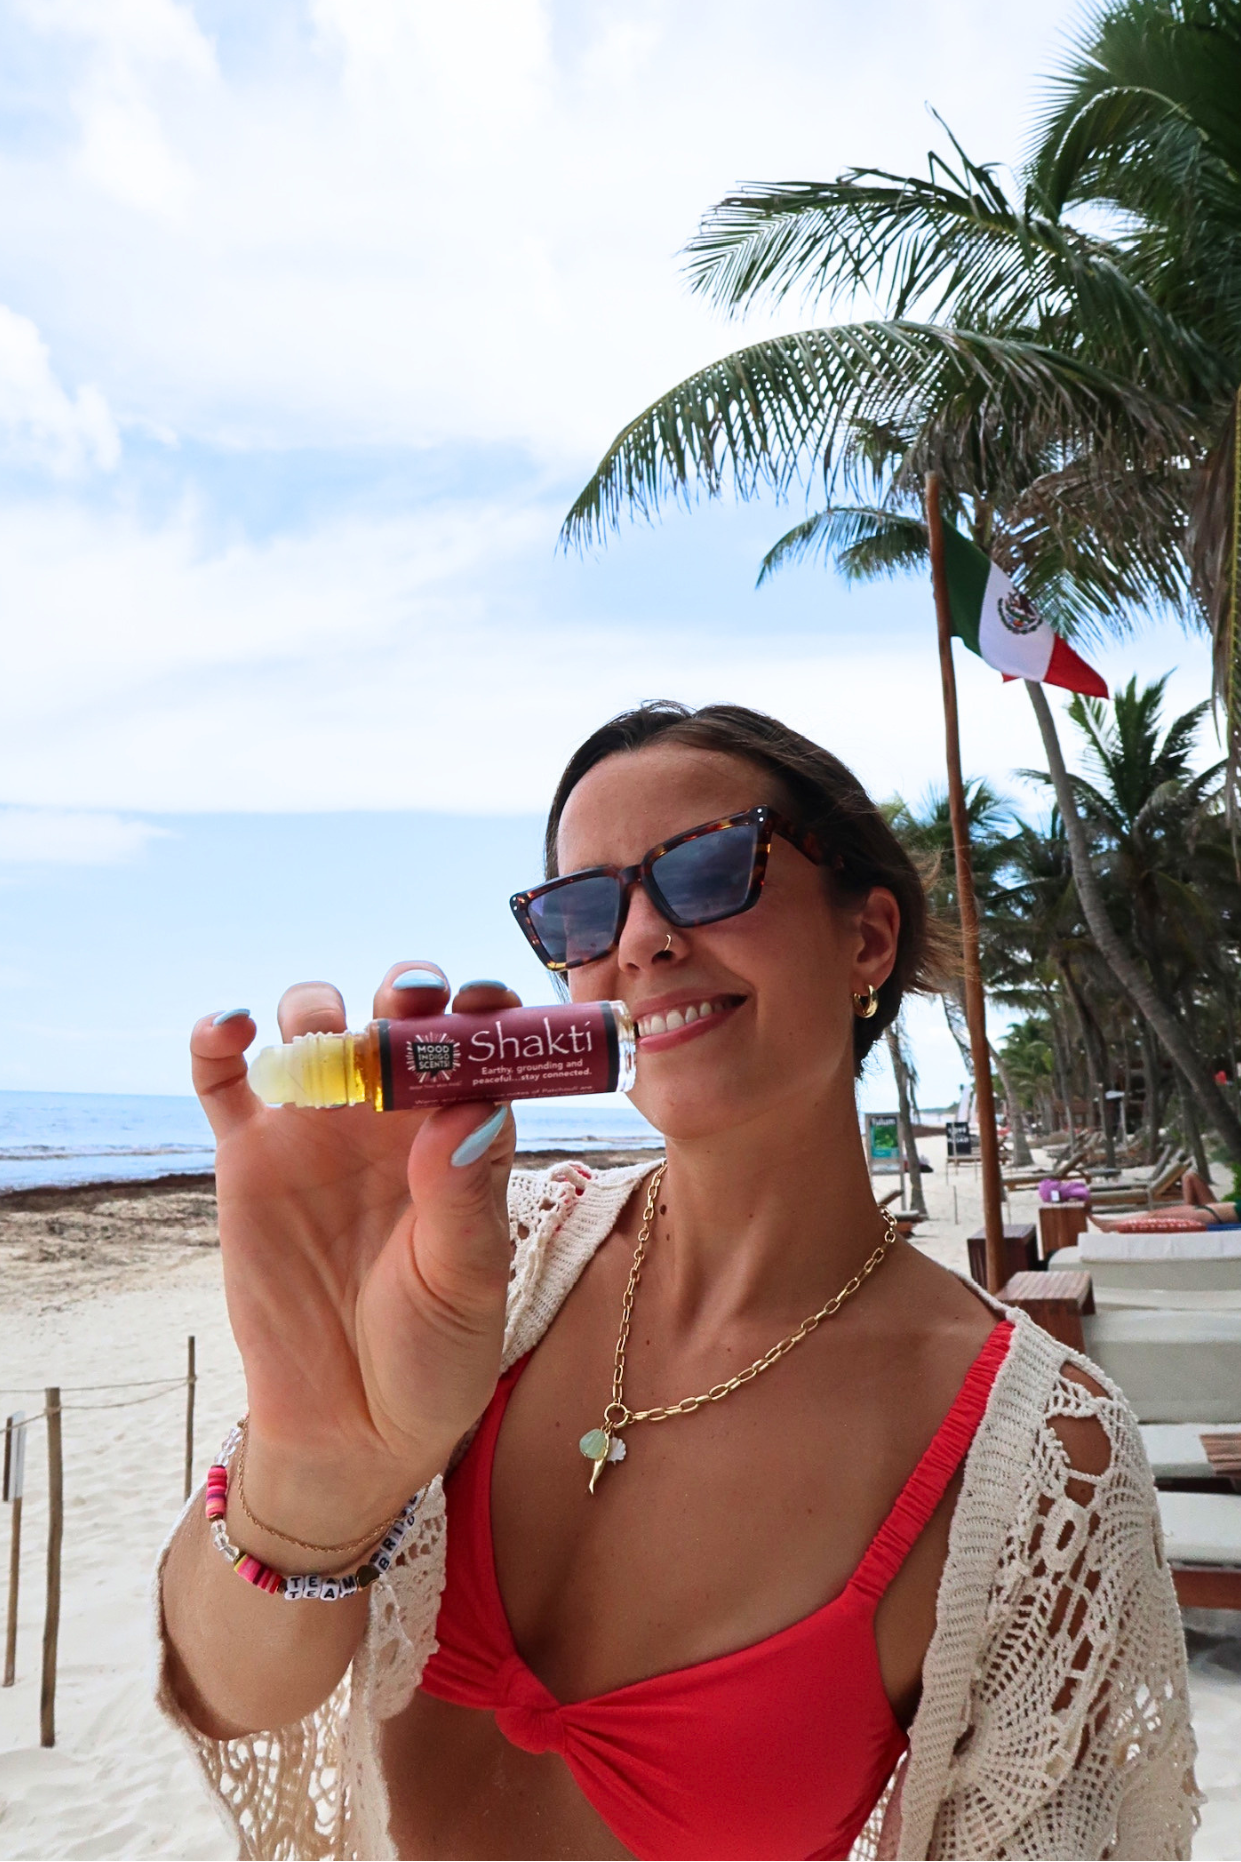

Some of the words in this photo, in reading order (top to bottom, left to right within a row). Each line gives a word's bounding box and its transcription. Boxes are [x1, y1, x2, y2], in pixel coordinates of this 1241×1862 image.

[468, 1017, 592, 1062] Shakti
[416, 1045, 450, 1053] MOOD
[418, 1053, 450, 1061] INDIGO
[516, 1061, 564, 1074] grounding
[566, 1059, 583, 1068] and
[542, 1068, 592, 1079] connected.
[290, 1575, 356, 1590] TEAM
